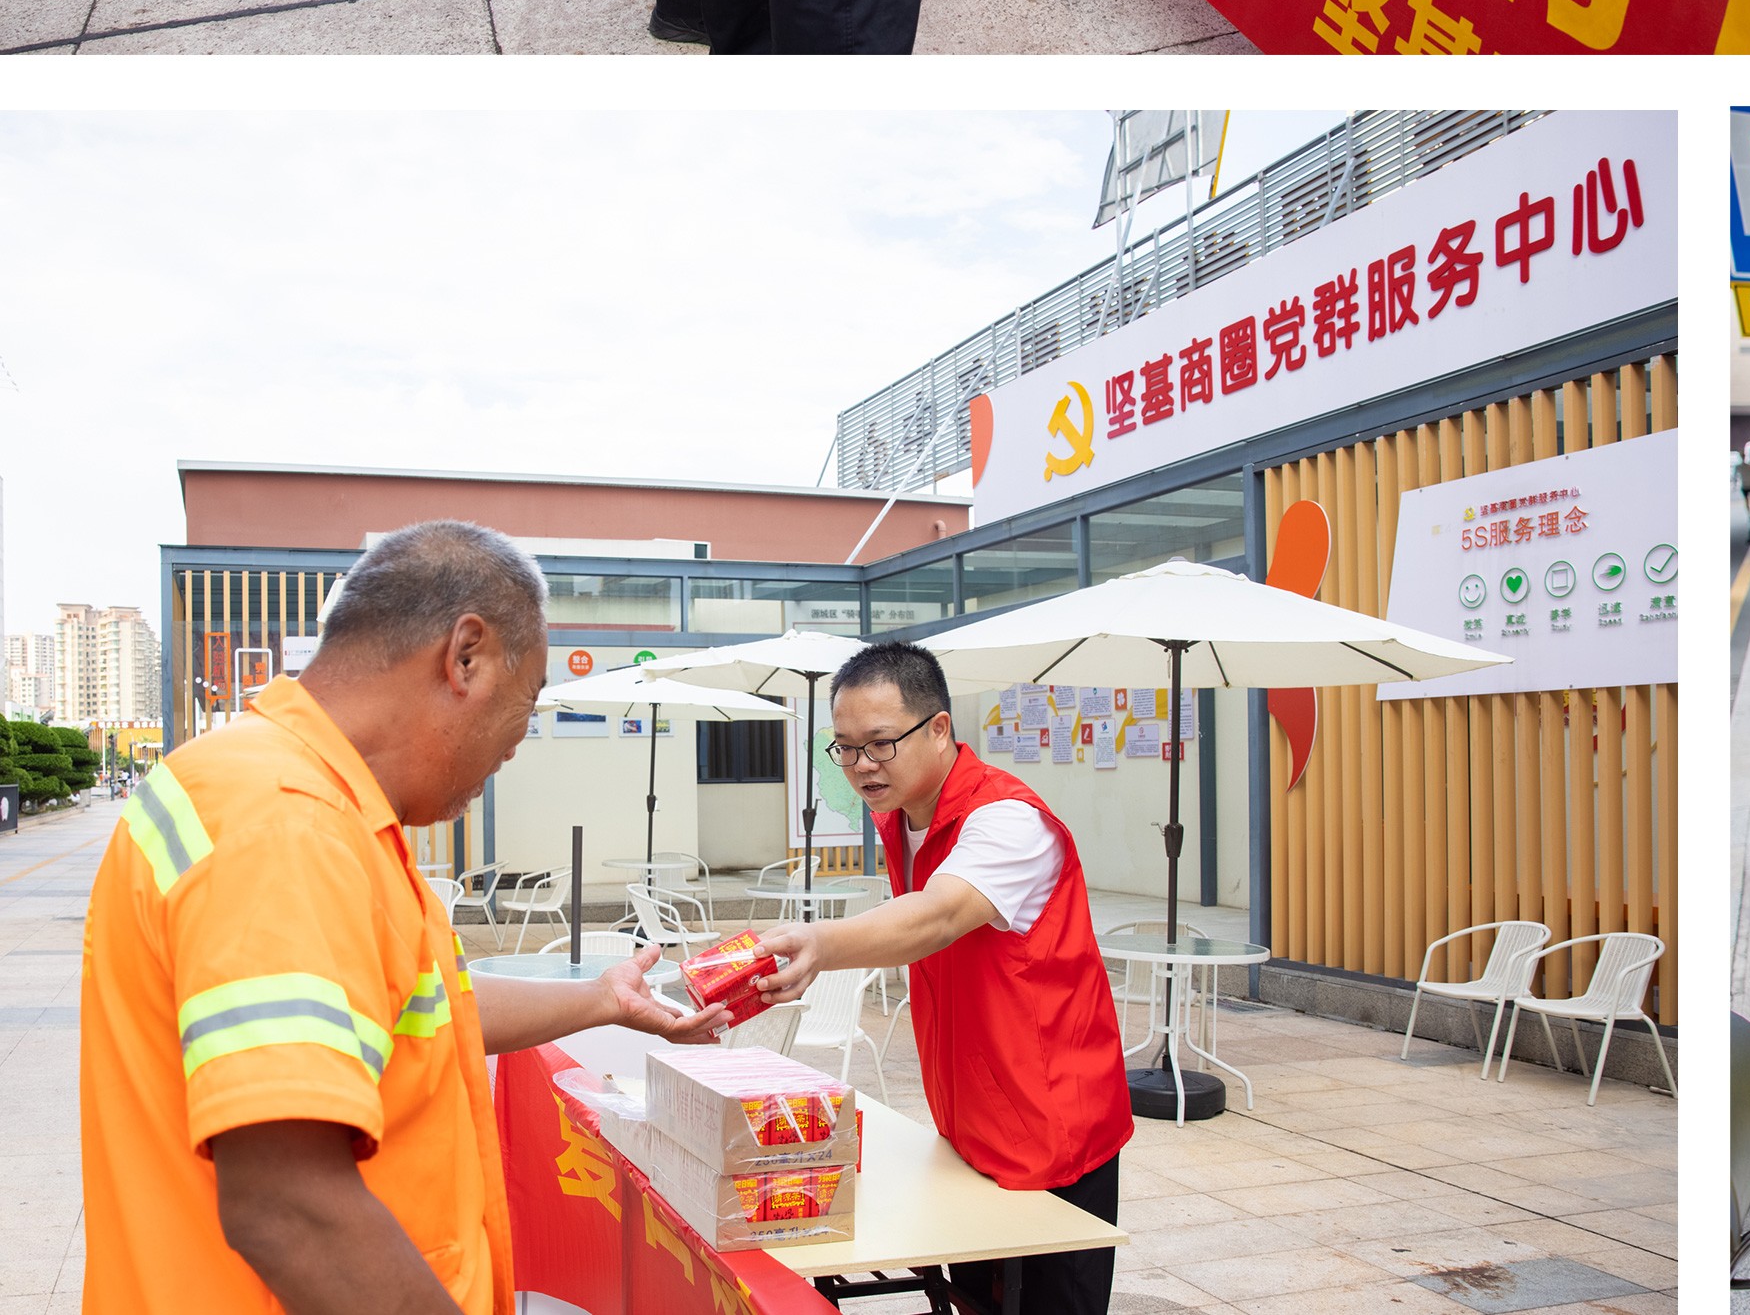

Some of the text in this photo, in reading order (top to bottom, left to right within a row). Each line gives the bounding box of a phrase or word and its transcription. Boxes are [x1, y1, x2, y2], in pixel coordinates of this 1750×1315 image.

[1105, 156, 1645, 441] 坚基商圈党群服务中心
[1460, 505, 1589, 551] 5S服务理念
